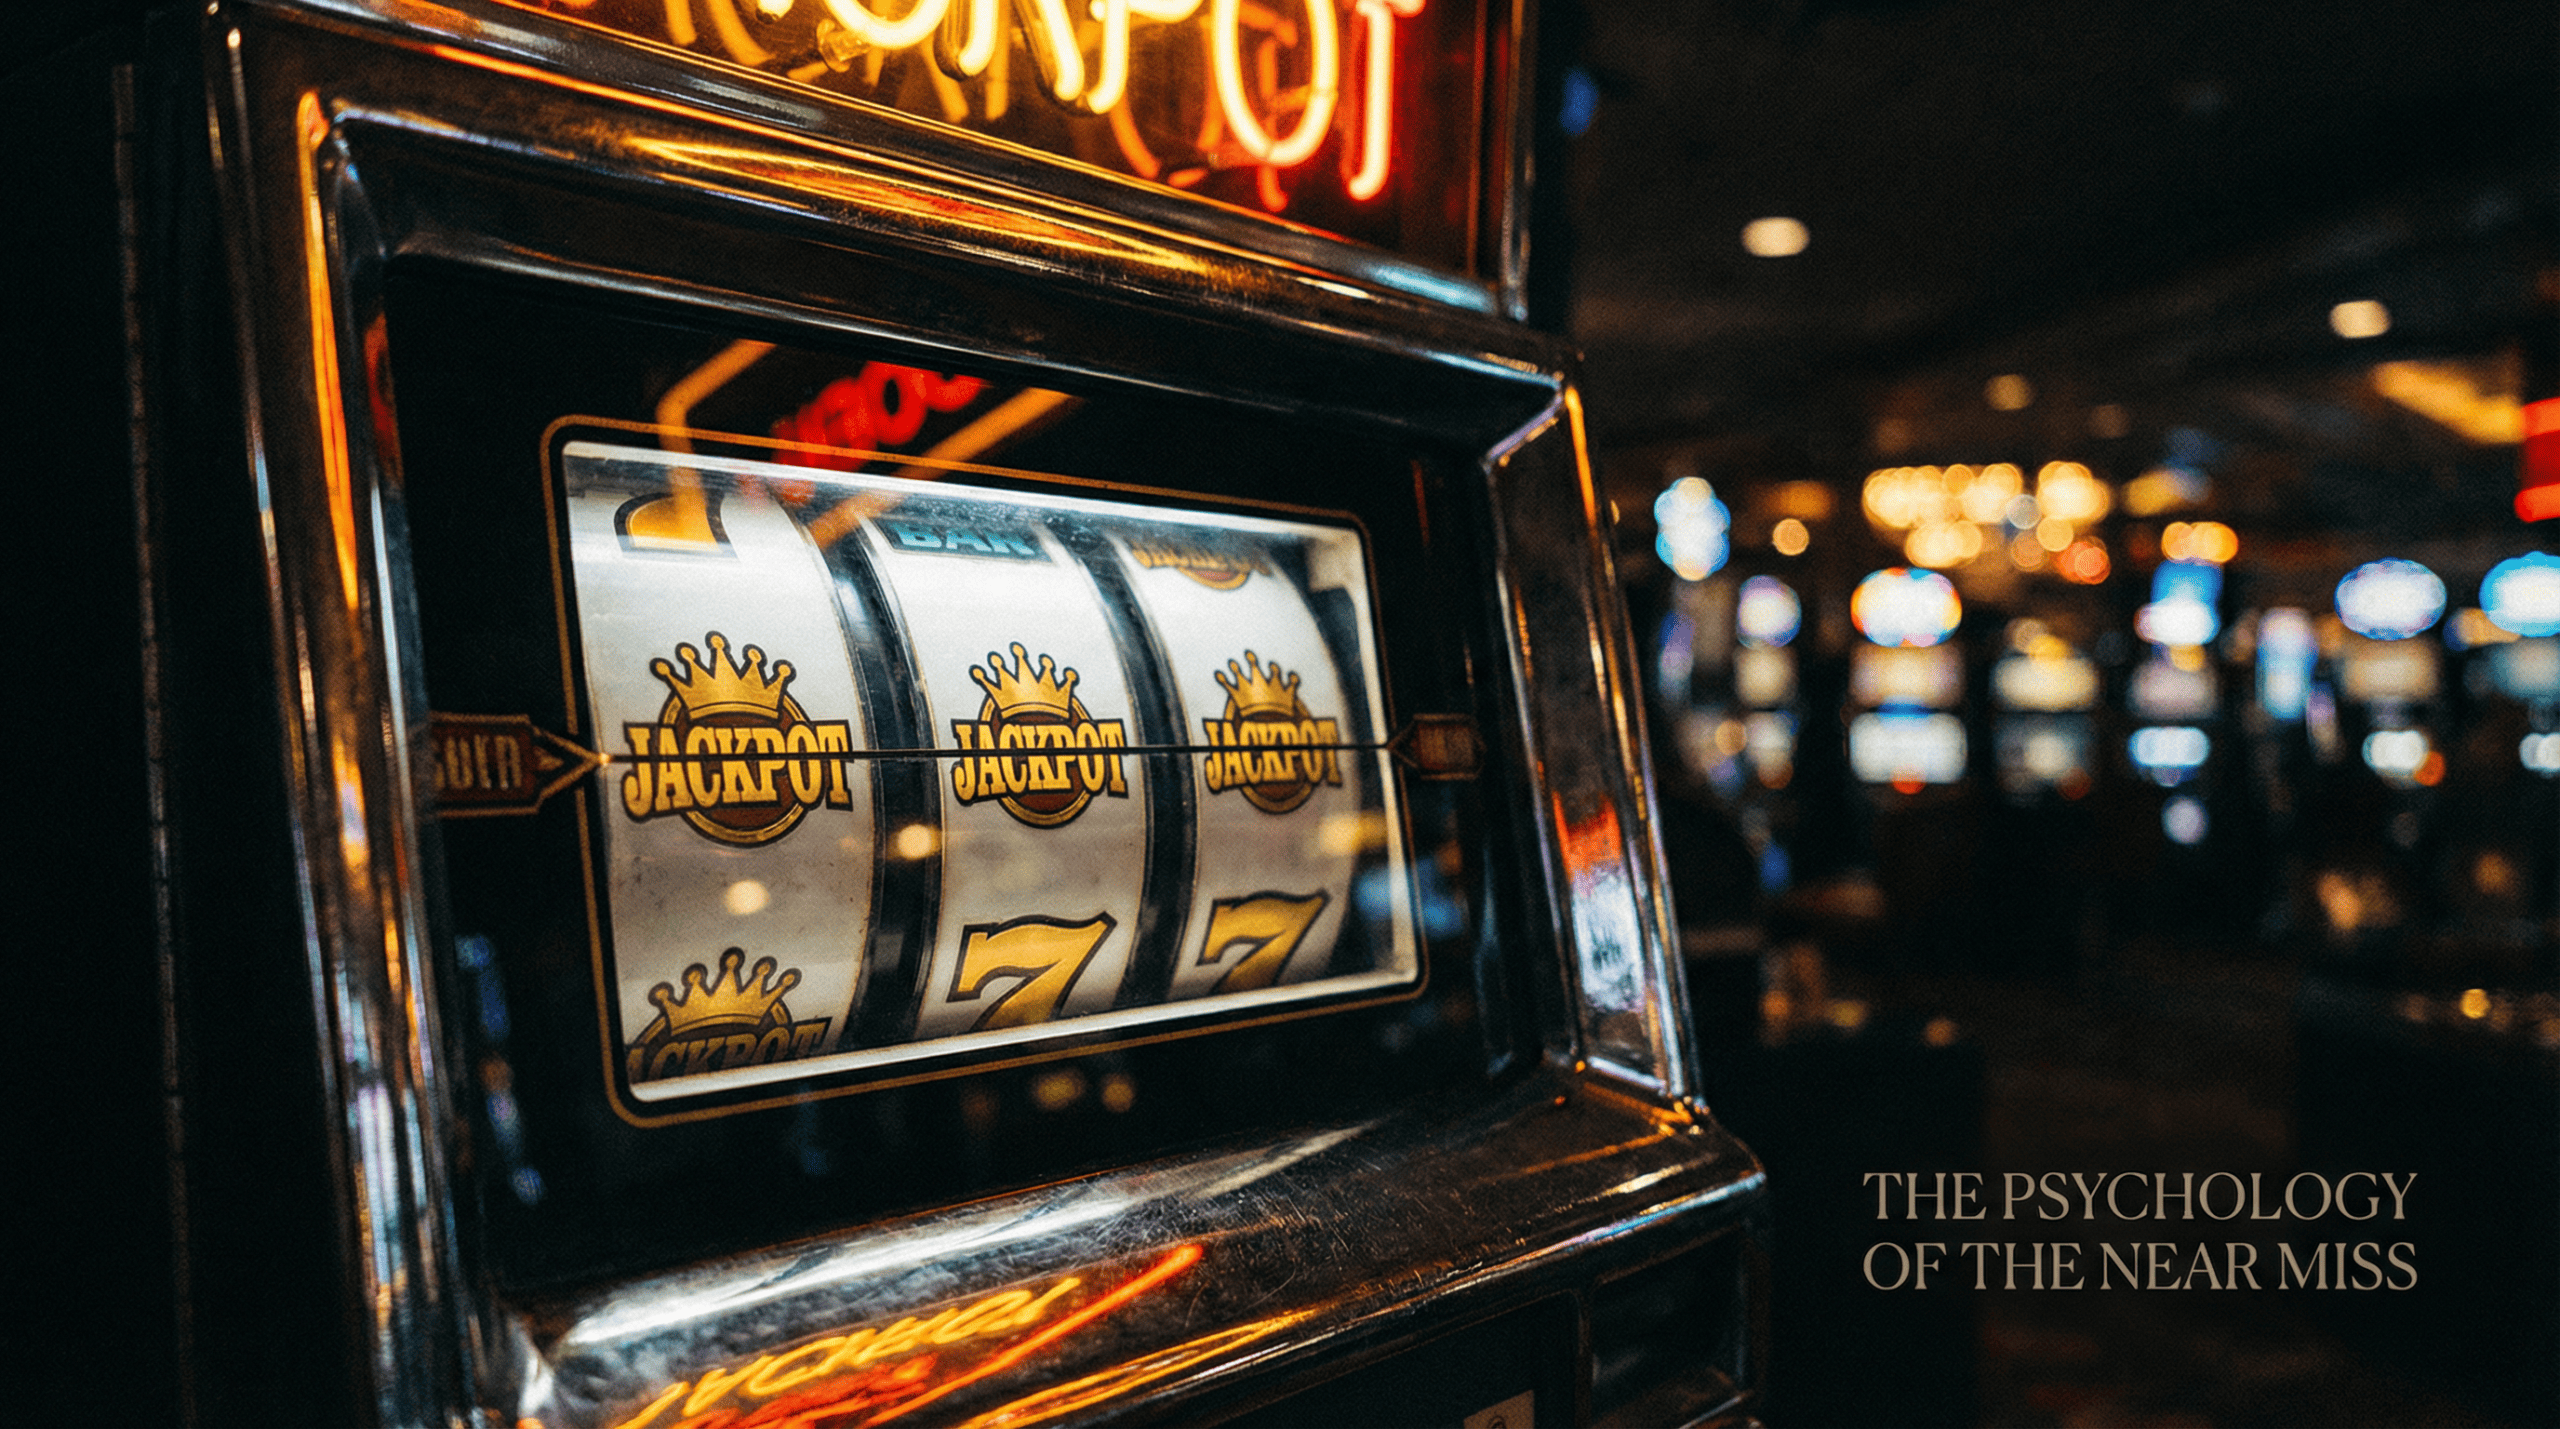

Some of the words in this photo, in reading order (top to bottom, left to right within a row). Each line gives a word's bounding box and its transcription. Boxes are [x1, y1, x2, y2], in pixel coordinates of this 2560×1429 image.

[623, 723, 851, 818] JACKPOT
[953, 721, 1127, 802] JACKPOT
[1204, 718, 1343, 792] JACKPOT
[947, 911, 1117, 1031] 7
[1196, 890, 1330, 996] 7
